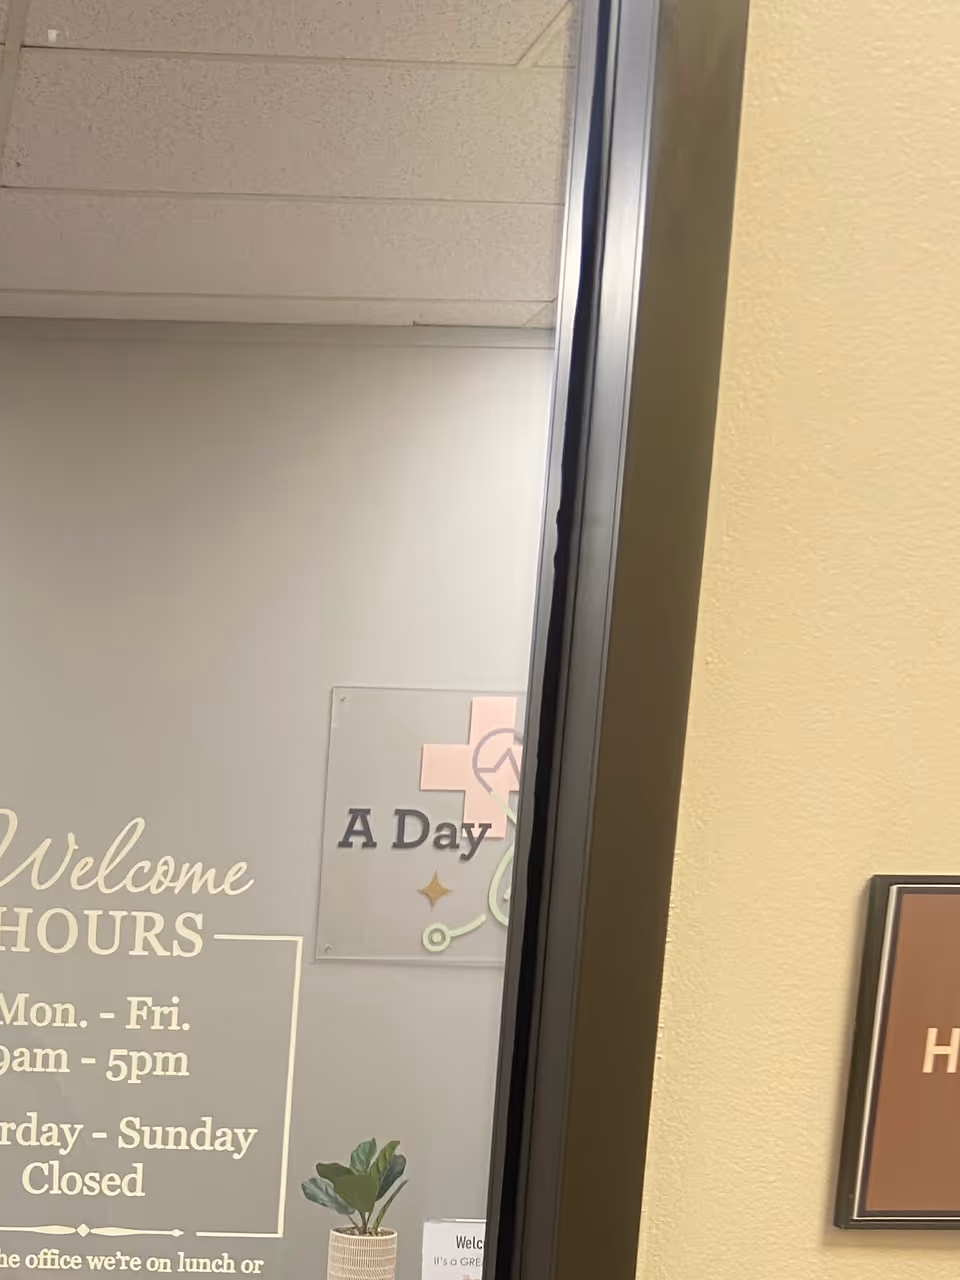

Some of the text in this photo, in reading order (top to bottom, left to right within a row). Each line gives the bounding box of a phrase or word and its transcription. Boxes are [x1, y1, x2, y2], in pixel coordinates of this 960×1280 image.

[337, 808, 492, 861] A Day
[125, 996, 190, 1030] Fri.
[105, 1049, 190, 1083] 5pm
[118, 1117, 258, 1159] Sunday
[21, 1160, 145, 1196] Closed
[456, 1235, 484, 1249] Welc
[25, 1249, 82, 1269] office
[86, 1251, 142, 1271] we're
[146, 1256, 172, 1273] on
[177, 1252, 236, 1273] lunch
[240, 1259, 265, 1274] or
[460, 1257, 483, 1267] GRE
